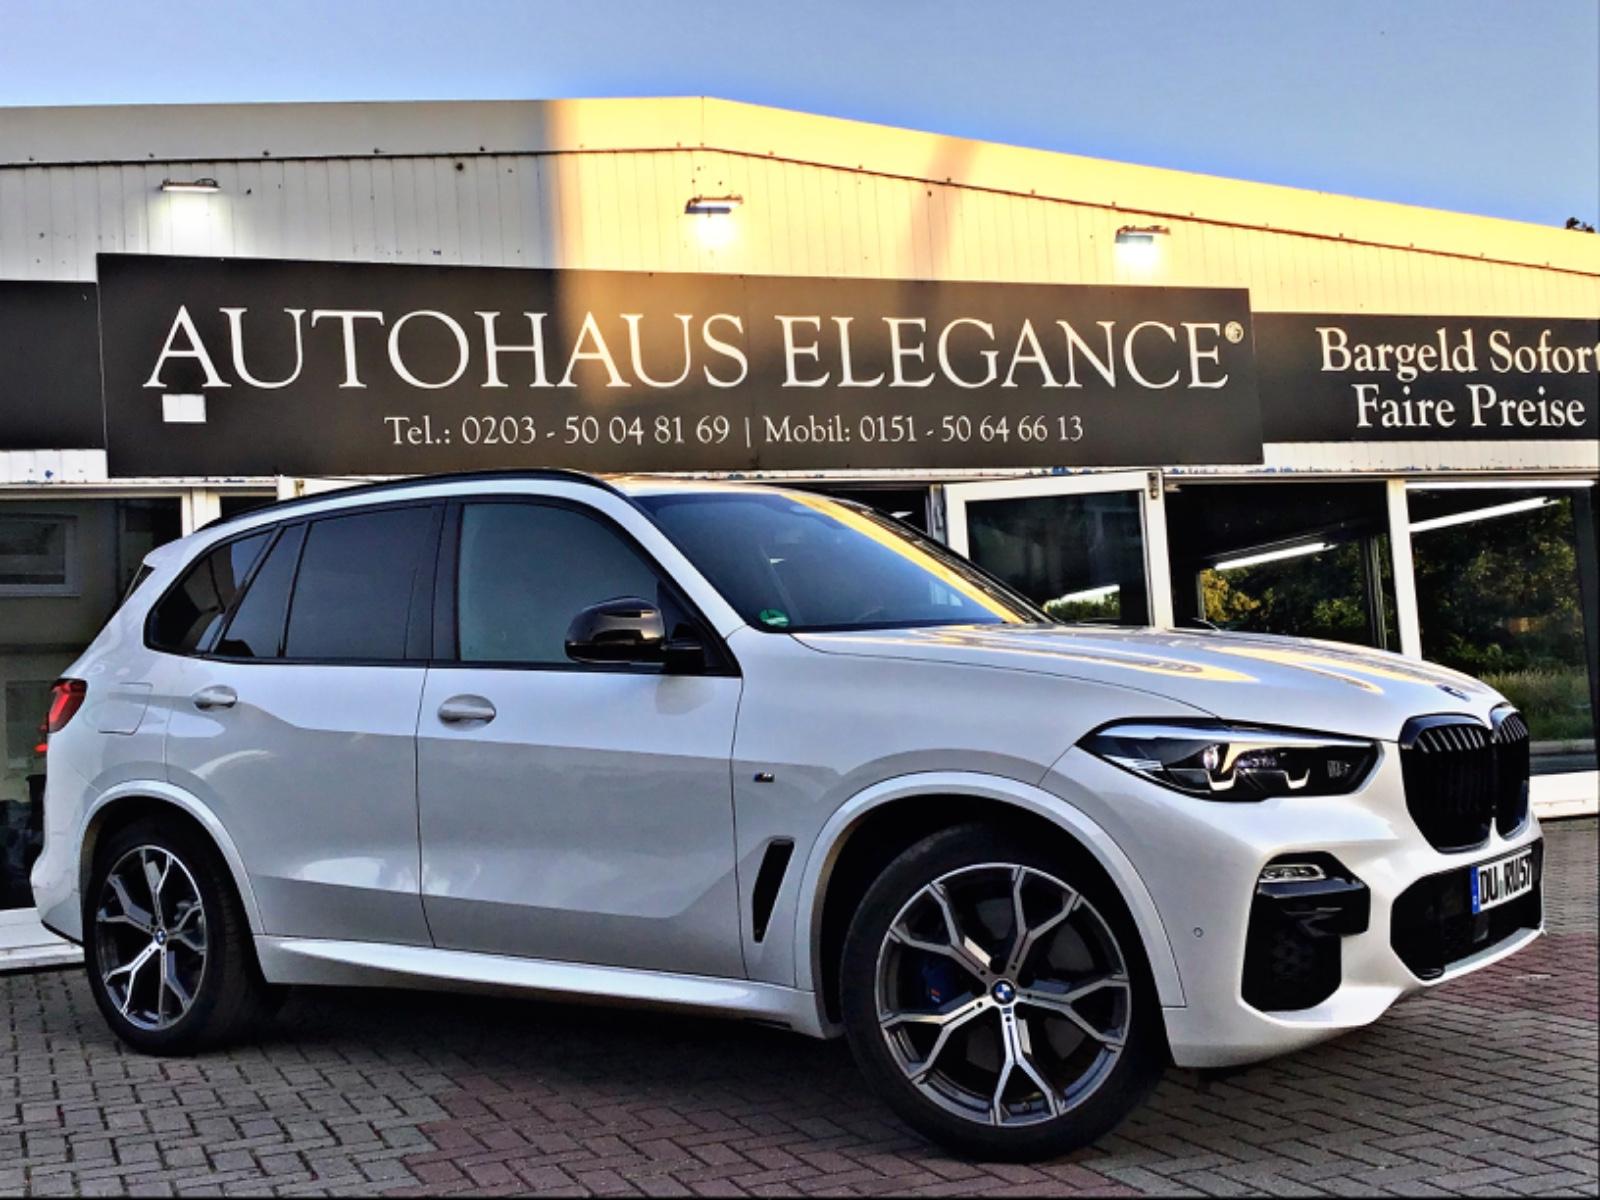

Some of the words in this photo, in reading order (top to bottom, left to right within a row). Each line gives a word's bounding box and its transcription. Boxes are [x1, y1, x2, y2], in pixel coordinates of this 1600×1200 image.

[142, 305, 748, 390] AUTOHAUS
[773, 314, 1228, 389] ELEGANCE
[1315, 326, 1478, 382] Bargeld
[1351, 383, 1456, 428] Faire
[1466, 384, 1586, 428] Preise
[384, 415, 450, 445] Tel.:
[462, 415, 536, 445] 0203
[565, 415, 599, 445] 50
[609, 415, 645, 445] 04
[654, 415, 683, 445] 81
[696, 415, 730, 445] 69
[763, 413, 851, 443] Mobil:
[859, 414, 917, 443] 0151
[942, 414, 972, 443] 50
[979, 414, 1010, 443] 64
[1017, 414, 1048, 443] 66
[1057, 415, 1084, 443] 13
[1479, 866, 1500, 904] DU
